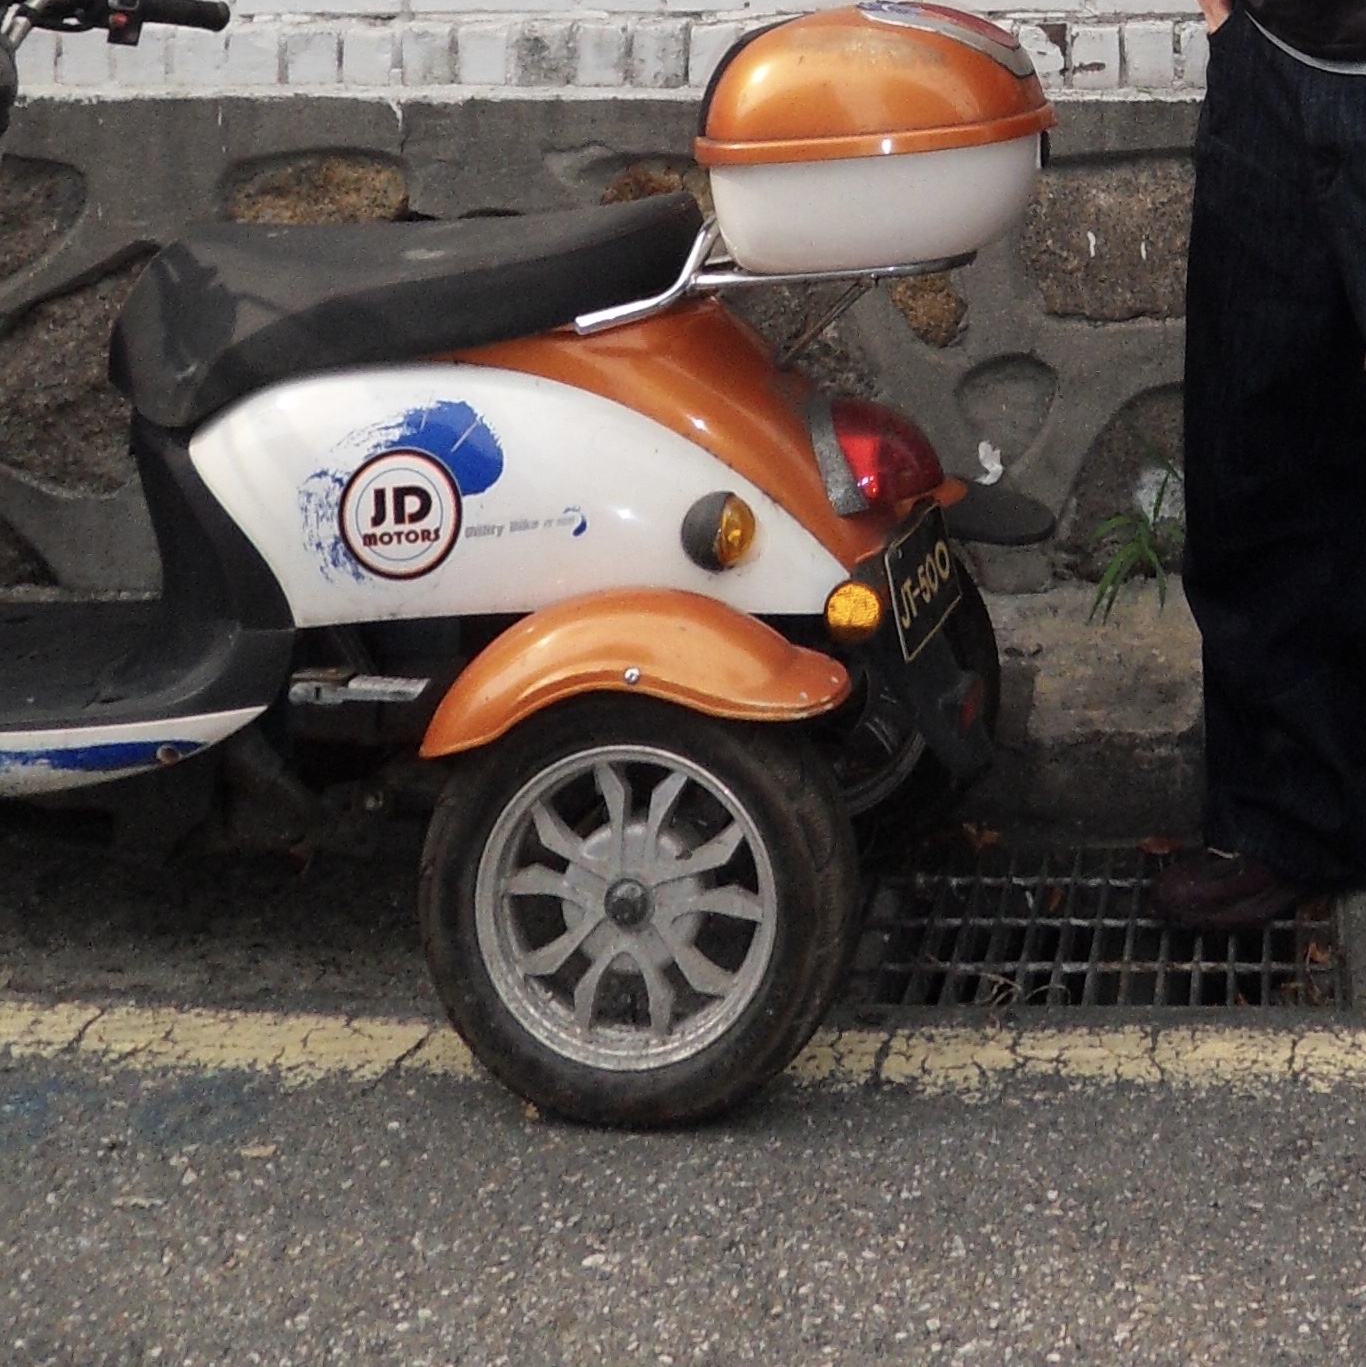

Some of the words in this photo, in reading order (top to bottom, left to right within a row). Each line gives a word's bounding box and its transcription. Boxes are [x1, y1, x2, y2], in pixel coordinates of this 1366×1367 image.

[370, 485, 432, 528] JD
[362, 527, 441, 547] MOTORS
[900, 541, 950, 629] JT-500
